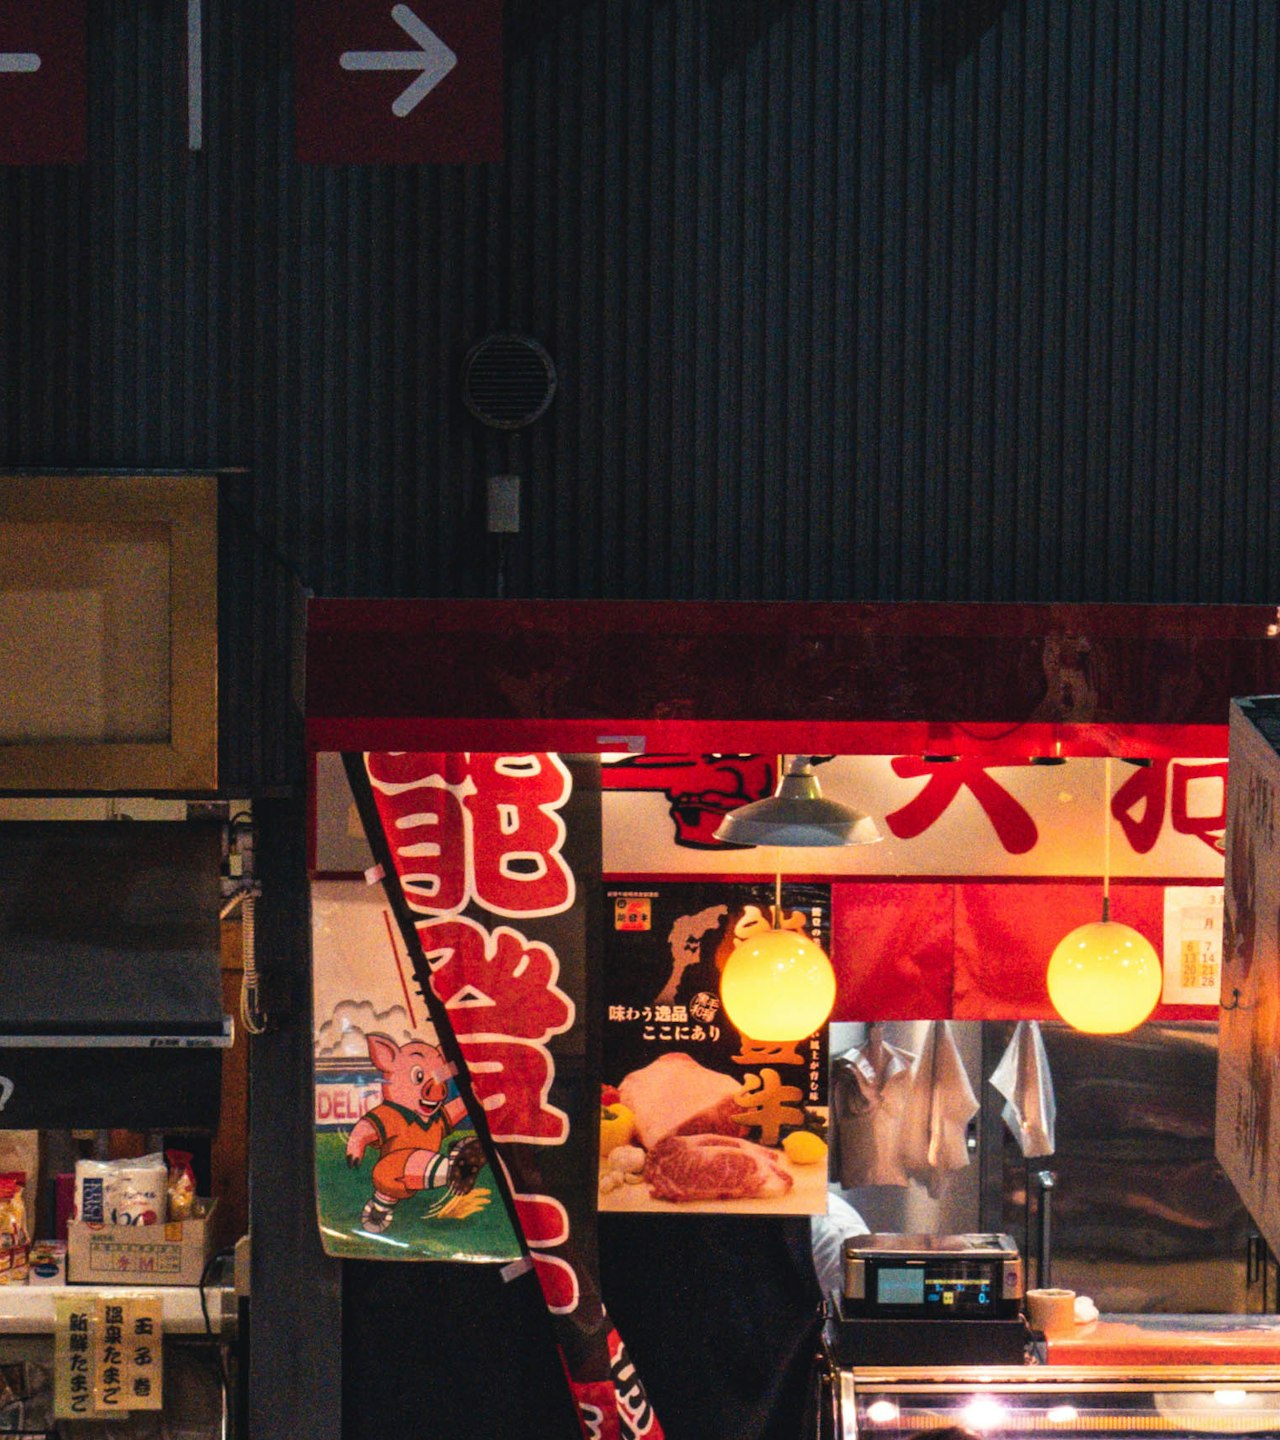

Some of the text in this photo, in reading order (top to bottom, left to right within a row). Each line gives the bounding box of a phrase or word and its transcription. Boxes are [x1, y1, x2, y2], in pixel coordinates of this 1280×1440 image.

[608, 1005, 688, 1022] 味わう逸品
[642, 1026, 721, 1042] ここにあり
